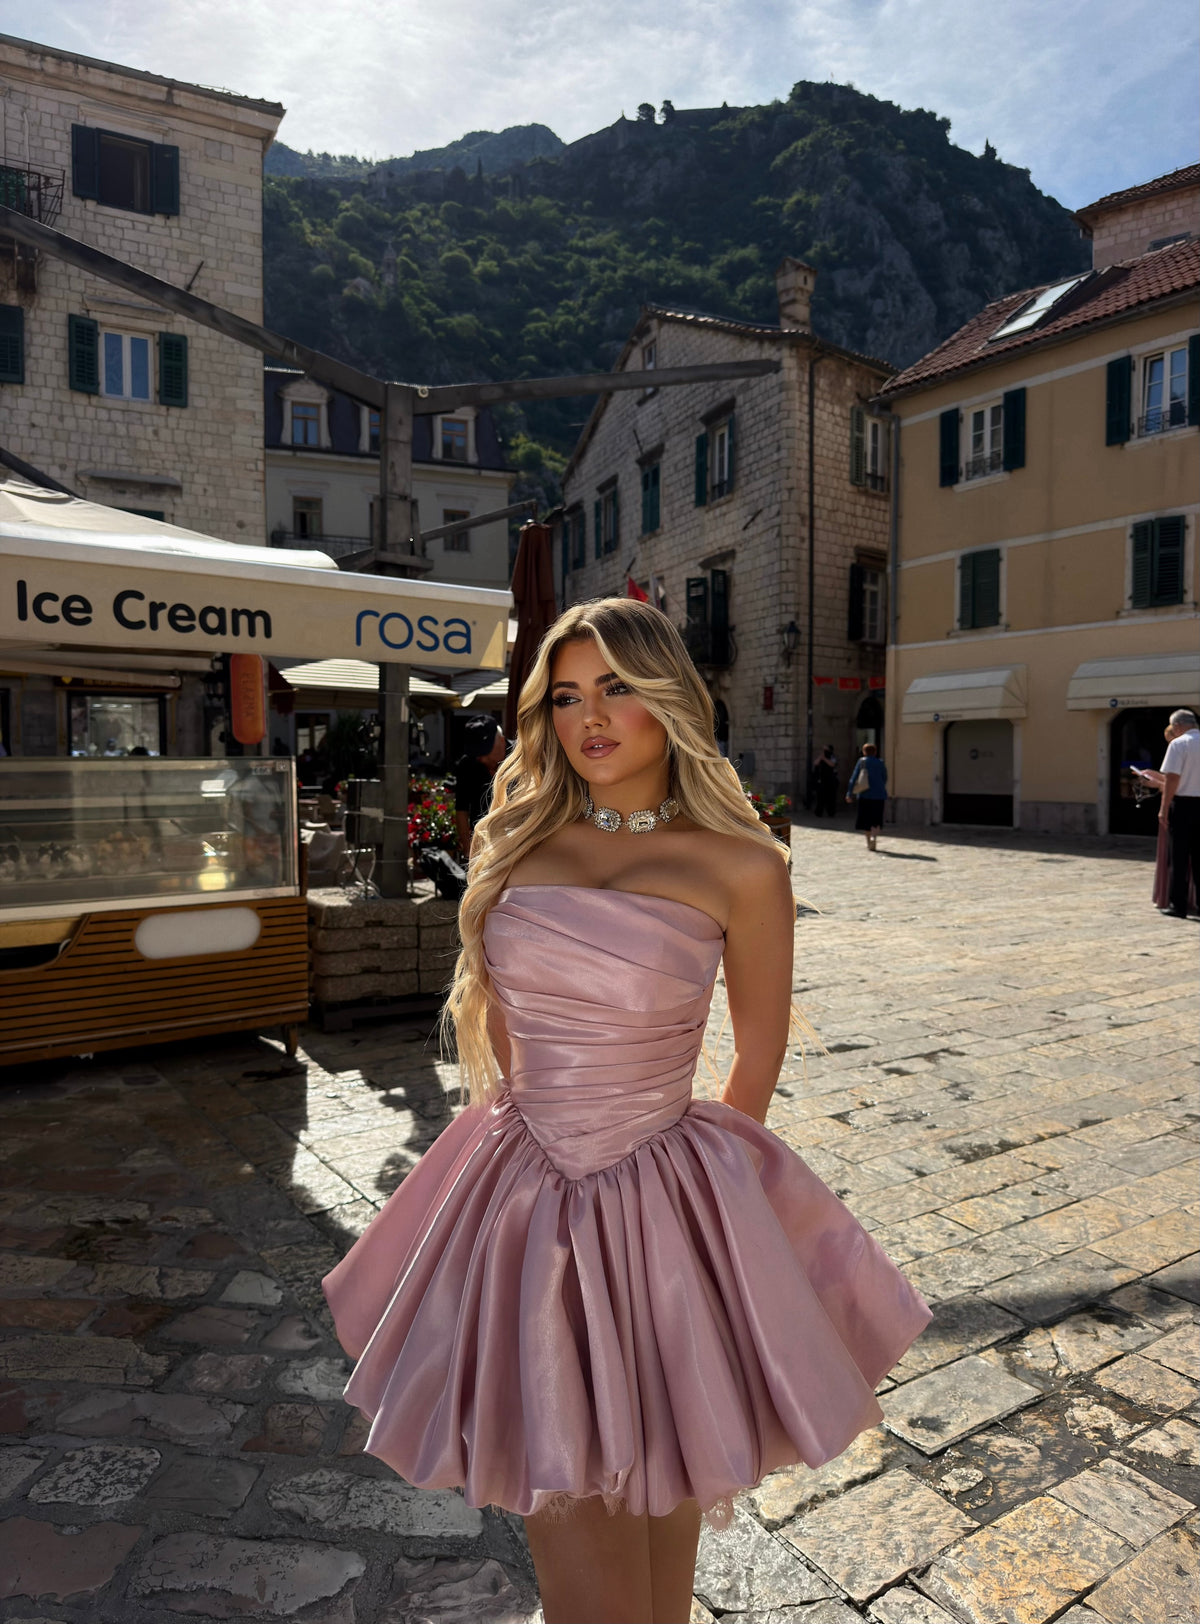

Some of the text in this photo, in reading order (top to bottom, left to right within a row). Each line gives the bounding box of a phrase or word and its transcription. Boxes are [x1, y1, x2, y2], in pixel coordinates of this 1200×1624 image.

[16, 579, 273, 640] Ice Cream
[355, 609, 472, 655] rosa
